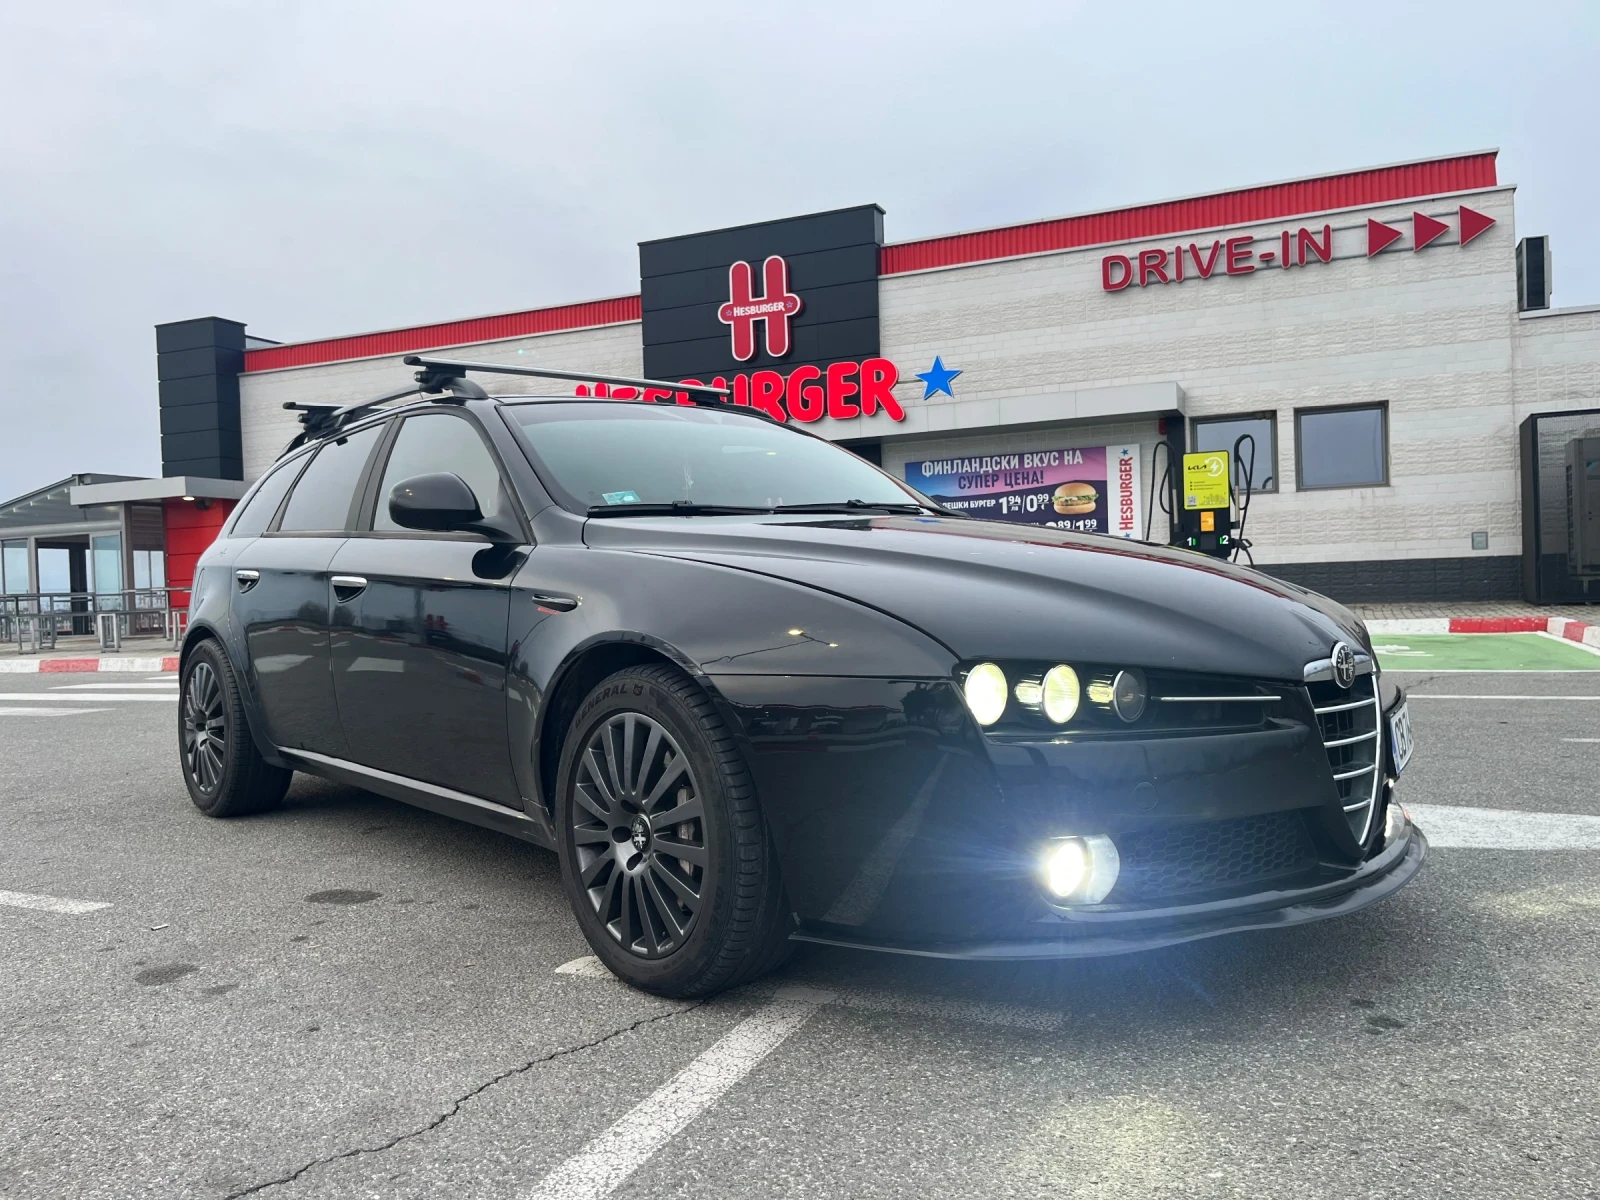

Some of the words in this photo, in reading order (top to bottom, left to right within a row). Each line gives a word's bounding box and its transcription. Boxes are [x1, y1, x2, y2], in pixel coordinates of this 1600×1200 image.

[1101, 223, 1333, 292] DRIVE-IN
[733, 302, 786, 317] HESBURGER
[921, 455, 1019, 477] ФИНЛАНДСКИ
[1024, 452, 1059, 469] ВКУС
[1064, 450, 1083, 465] НА
[958, 473, 999, 490] СУПЕР
[1004, 470, 1044, 488] ЦЕНА!
[1119, 457, 1134, 530] HESBURGER
[970, 500, 996, 509] БУРГЕР
[1187, 537, 1192, 546] 1
[1222, 535, 1229, 545] 2
[574, 683, 628, 729] GENERAL
